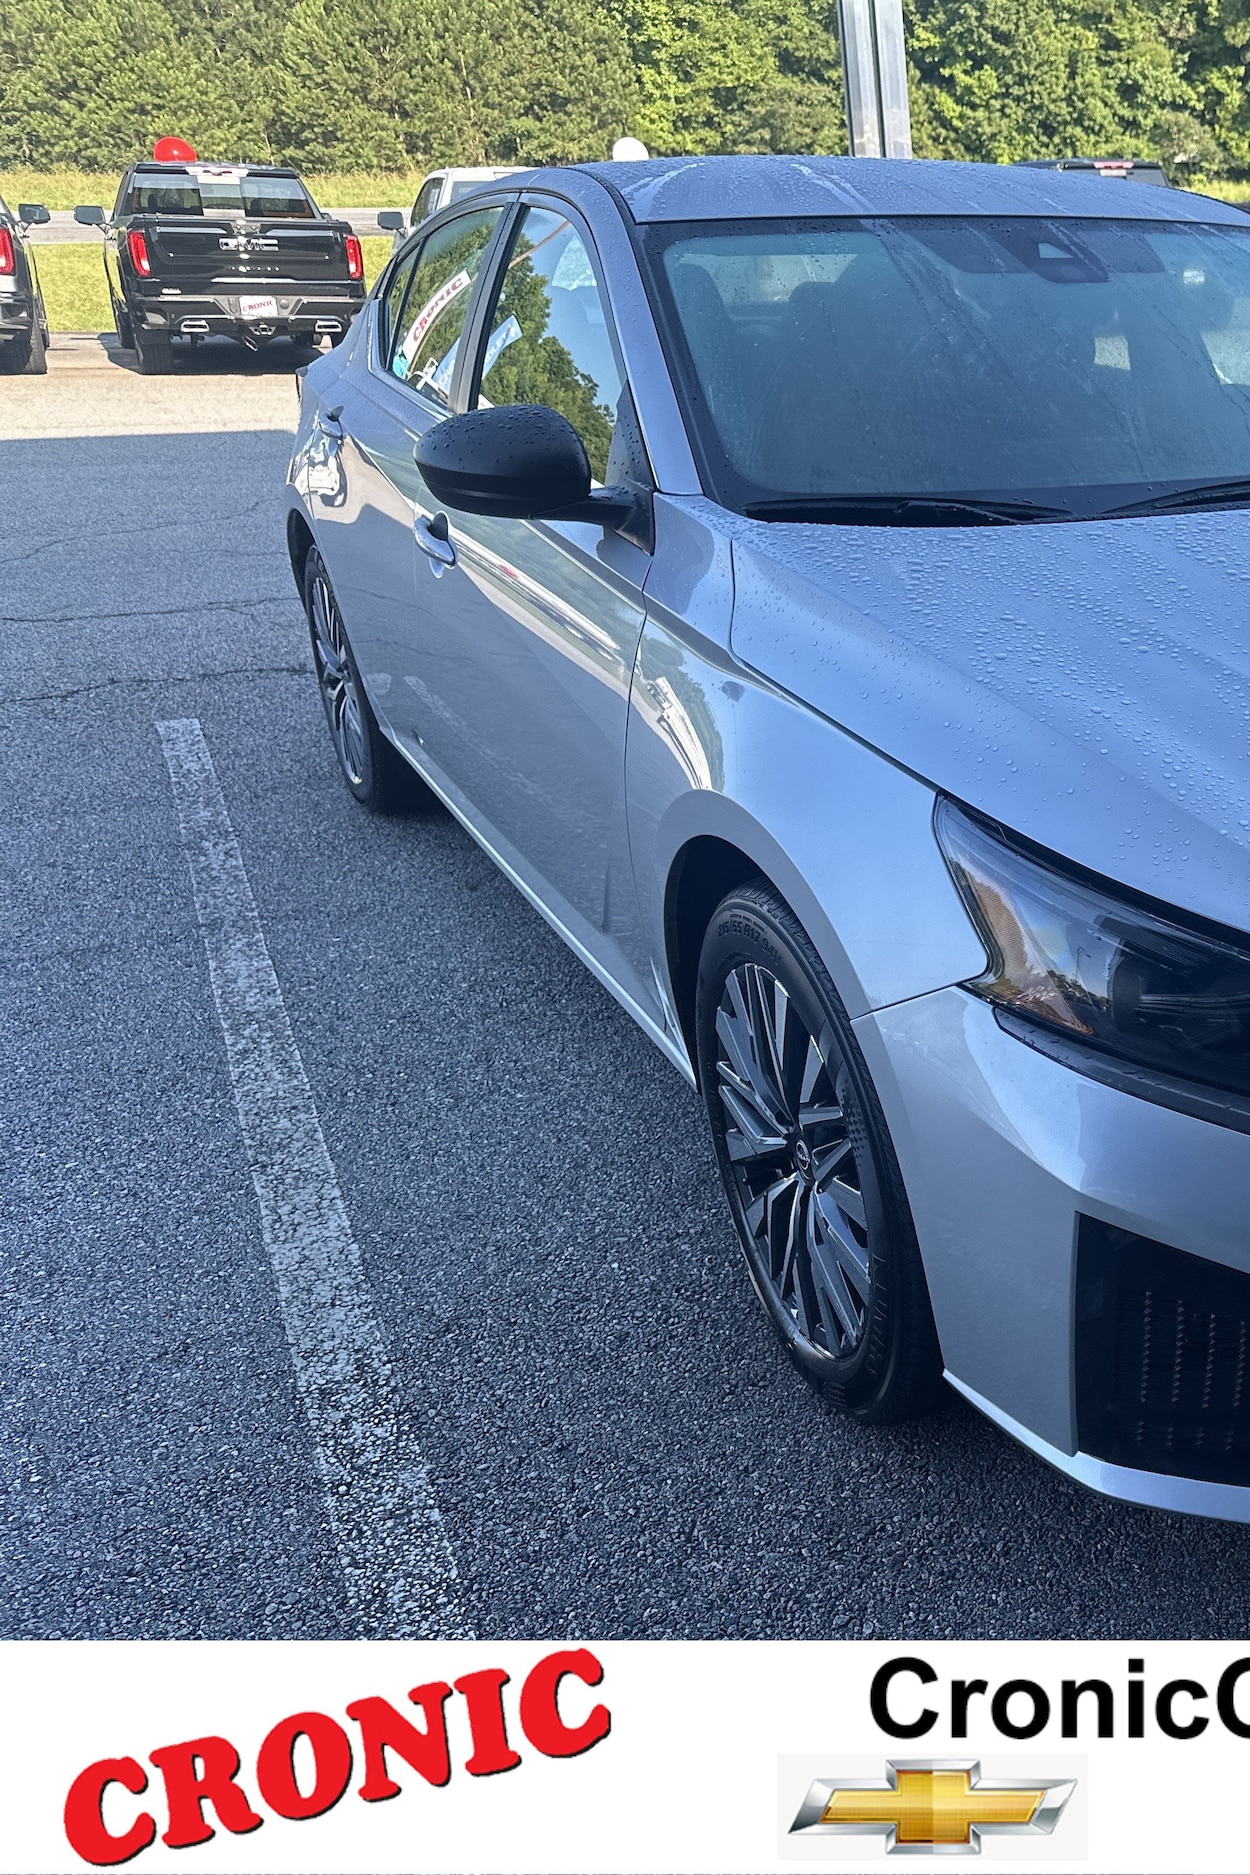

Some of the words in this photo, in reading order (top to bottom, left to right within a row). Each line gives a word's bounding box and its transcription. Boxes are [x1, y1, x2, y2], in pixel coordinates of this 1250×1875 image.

[242, 300, 273, 312] CRONIC
[413, 277, 463, 342] CRONIC
[718, 920, 742, 938] 215/55
[743, 924, 761, 945] R17
